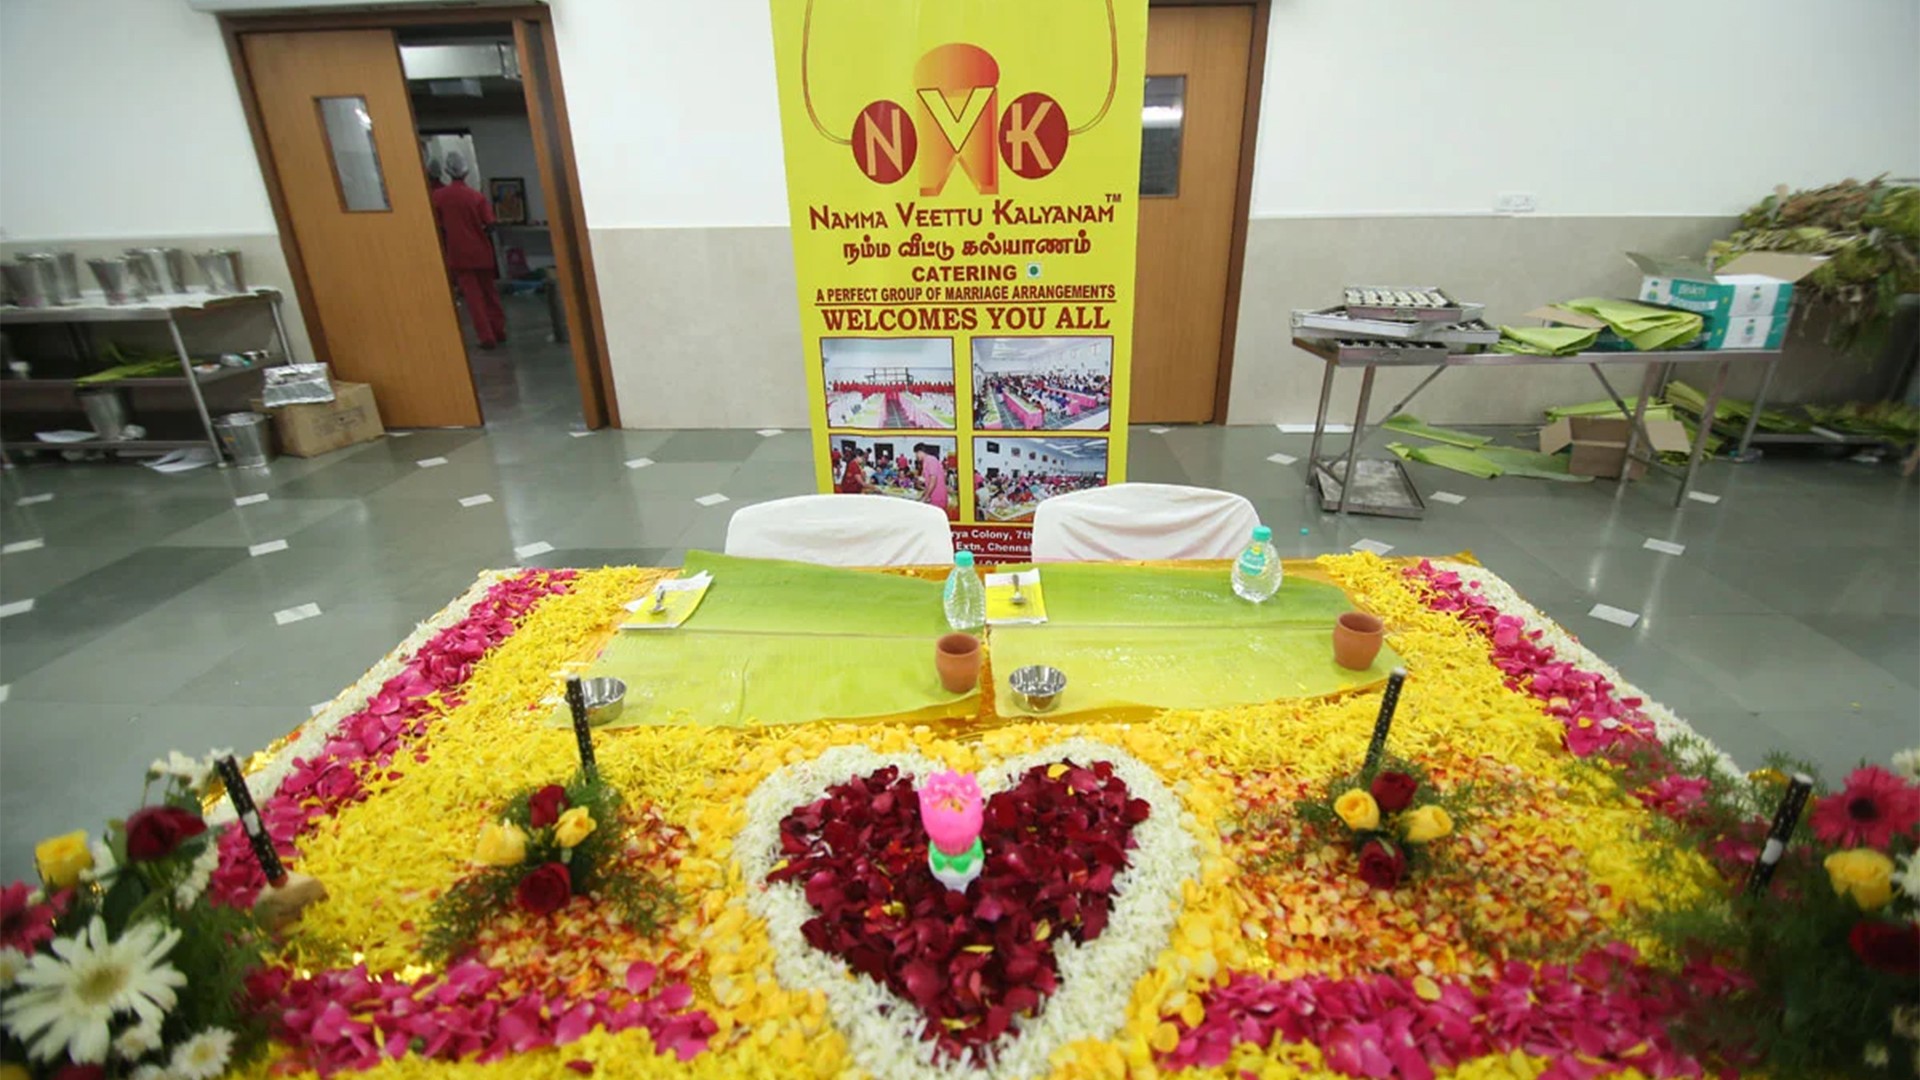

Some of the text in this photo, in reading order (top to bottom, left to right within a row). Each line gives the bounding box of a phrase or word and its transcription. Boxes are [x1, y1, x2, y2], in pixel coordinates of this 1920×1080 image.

[843, 229, 1091, 265] நம்ம வீட்டு கல்யாணம்
[911, 265, 1017, 282] CATERING
[816, 284, 1116, 302] A PERFECT GROUP OF MARRIAGE ARRANGEMENTS
[821, 306, 1111, 331] WELCOMES YOU ALL
[971, 529, 1013, 541] Colony,
[956, 541, 985, 552] Extn,
